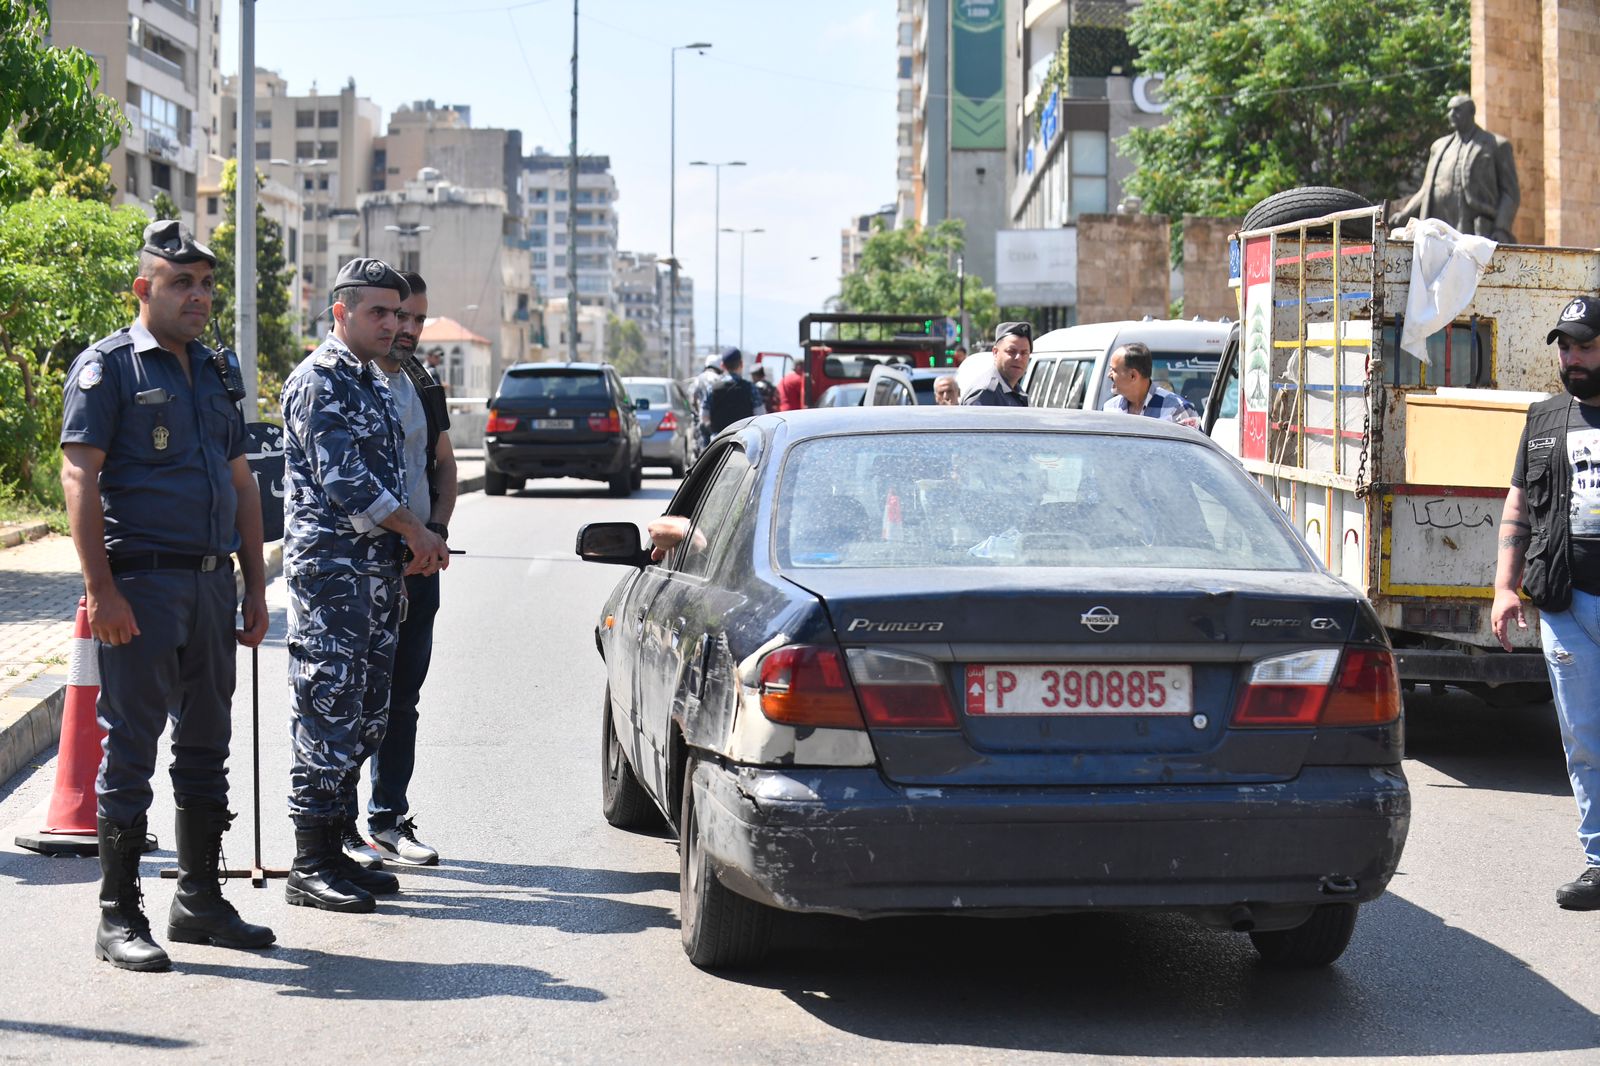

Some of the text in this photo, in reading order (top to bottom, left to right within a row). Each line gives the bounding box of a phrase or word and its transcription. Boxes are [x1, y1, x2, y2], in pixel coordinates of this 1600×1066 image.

[847, 617, 944, 632] Primera
[1310, 617, 1341, 630] GX
[996, 670, 1167, 708] P 390885
